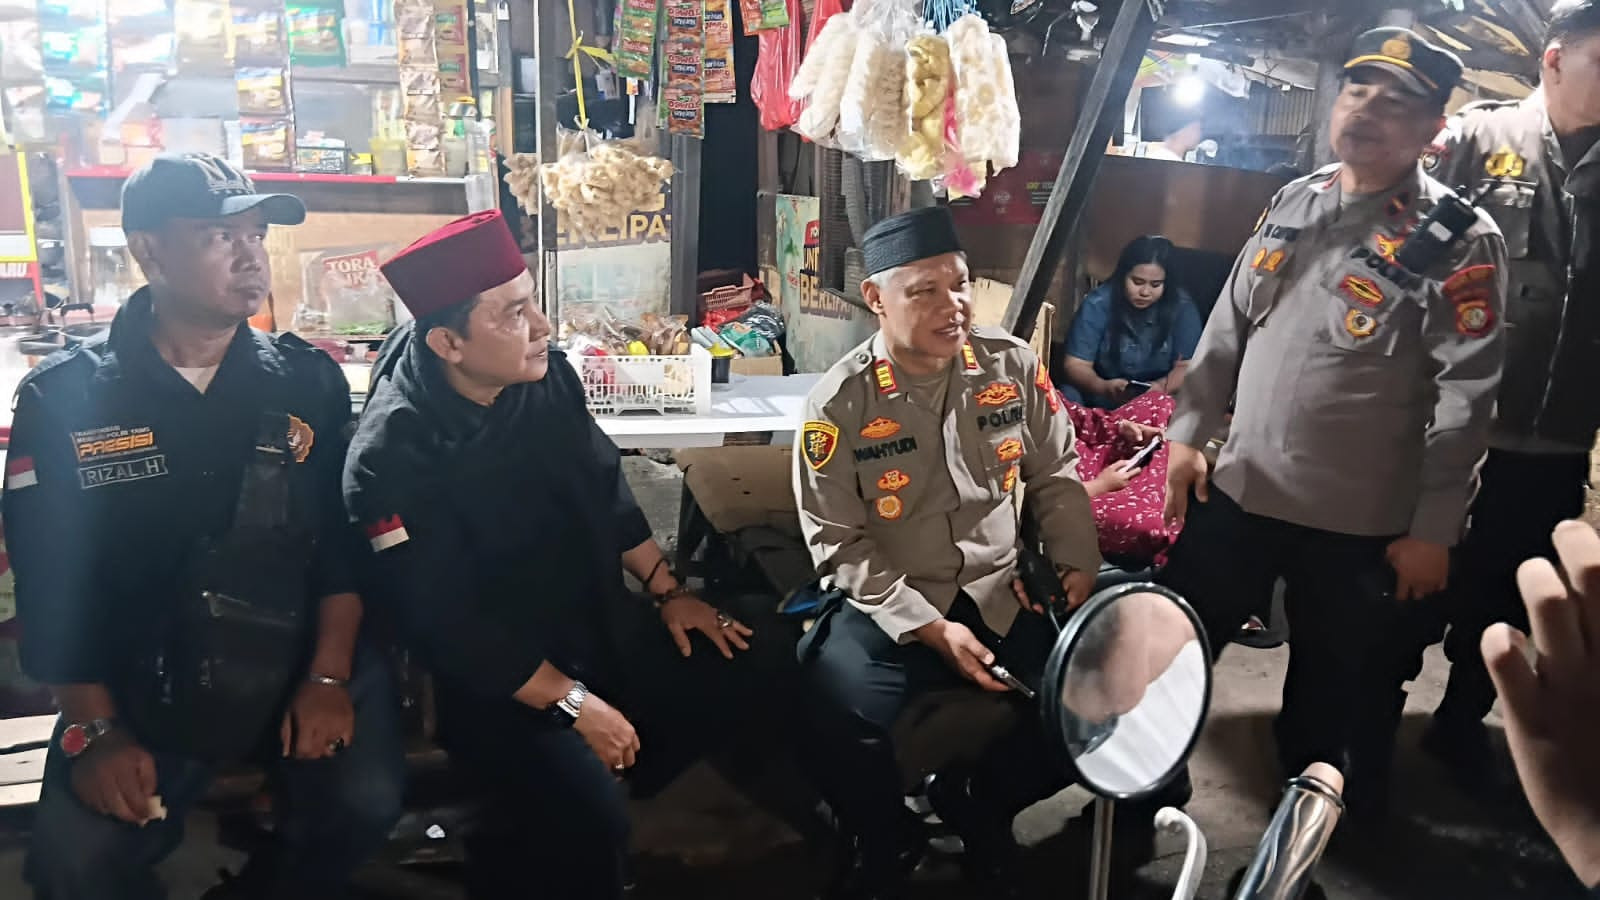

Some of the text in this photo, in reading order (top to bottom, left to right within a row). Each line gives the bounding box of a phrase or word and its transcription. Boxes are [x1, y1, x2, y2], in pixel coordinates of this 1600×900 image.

[325, 256, 377, 273] TORA
[79, 431, 154, 456] PRESISI
[854, 436, 918, 462] WAHYUDI
[86, 459, 160, 484] RIZAL.H
